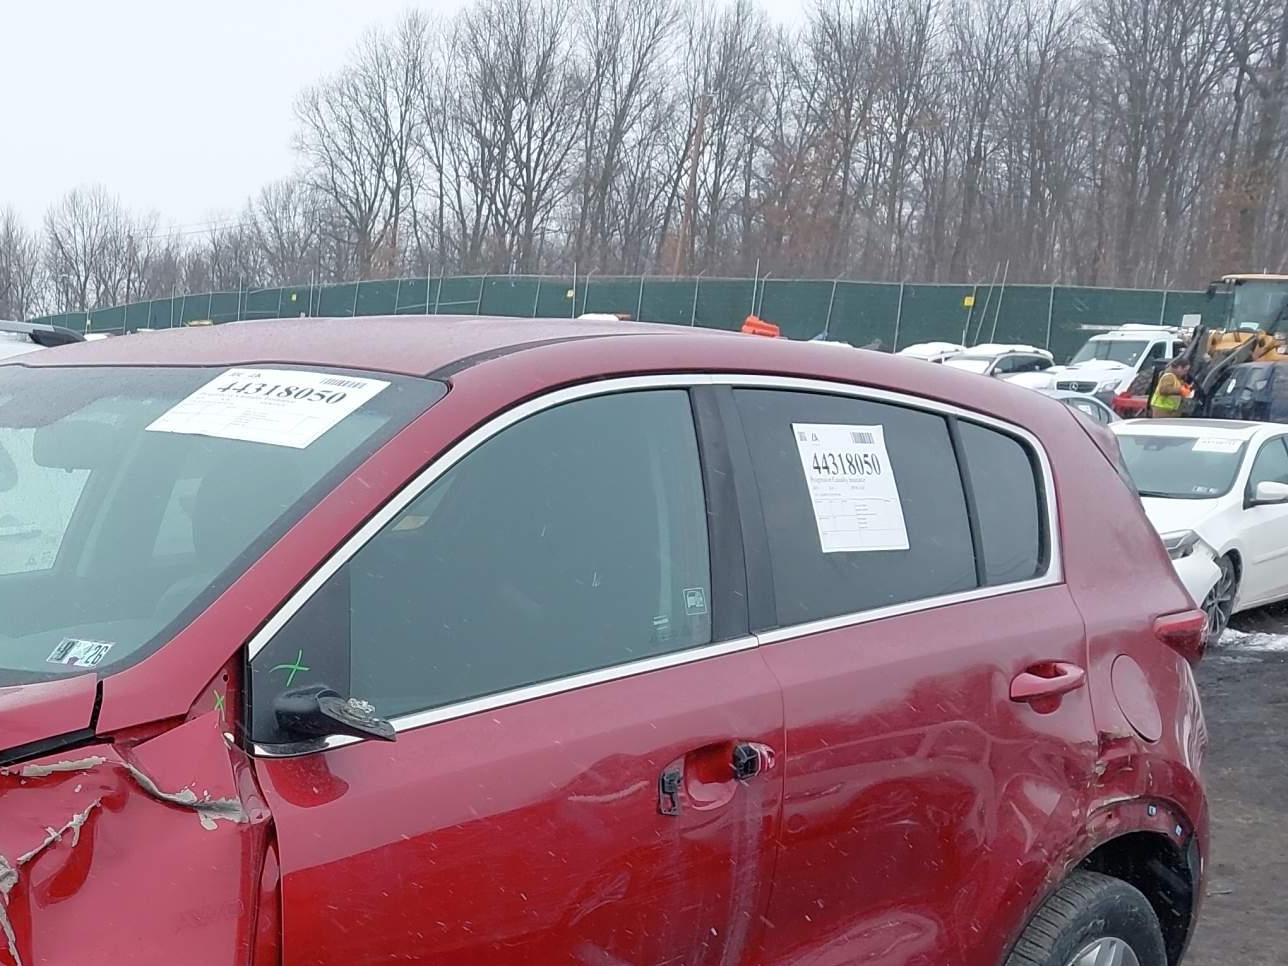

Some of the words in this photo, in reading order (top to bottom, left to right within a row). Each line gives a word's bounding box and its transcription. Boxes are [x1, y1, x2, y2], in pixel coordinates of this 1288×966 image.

[217, 380, 347, 405] 44318050
[812, 452, 881, 475] 44318050
[84, 645, 109, 665] 26
